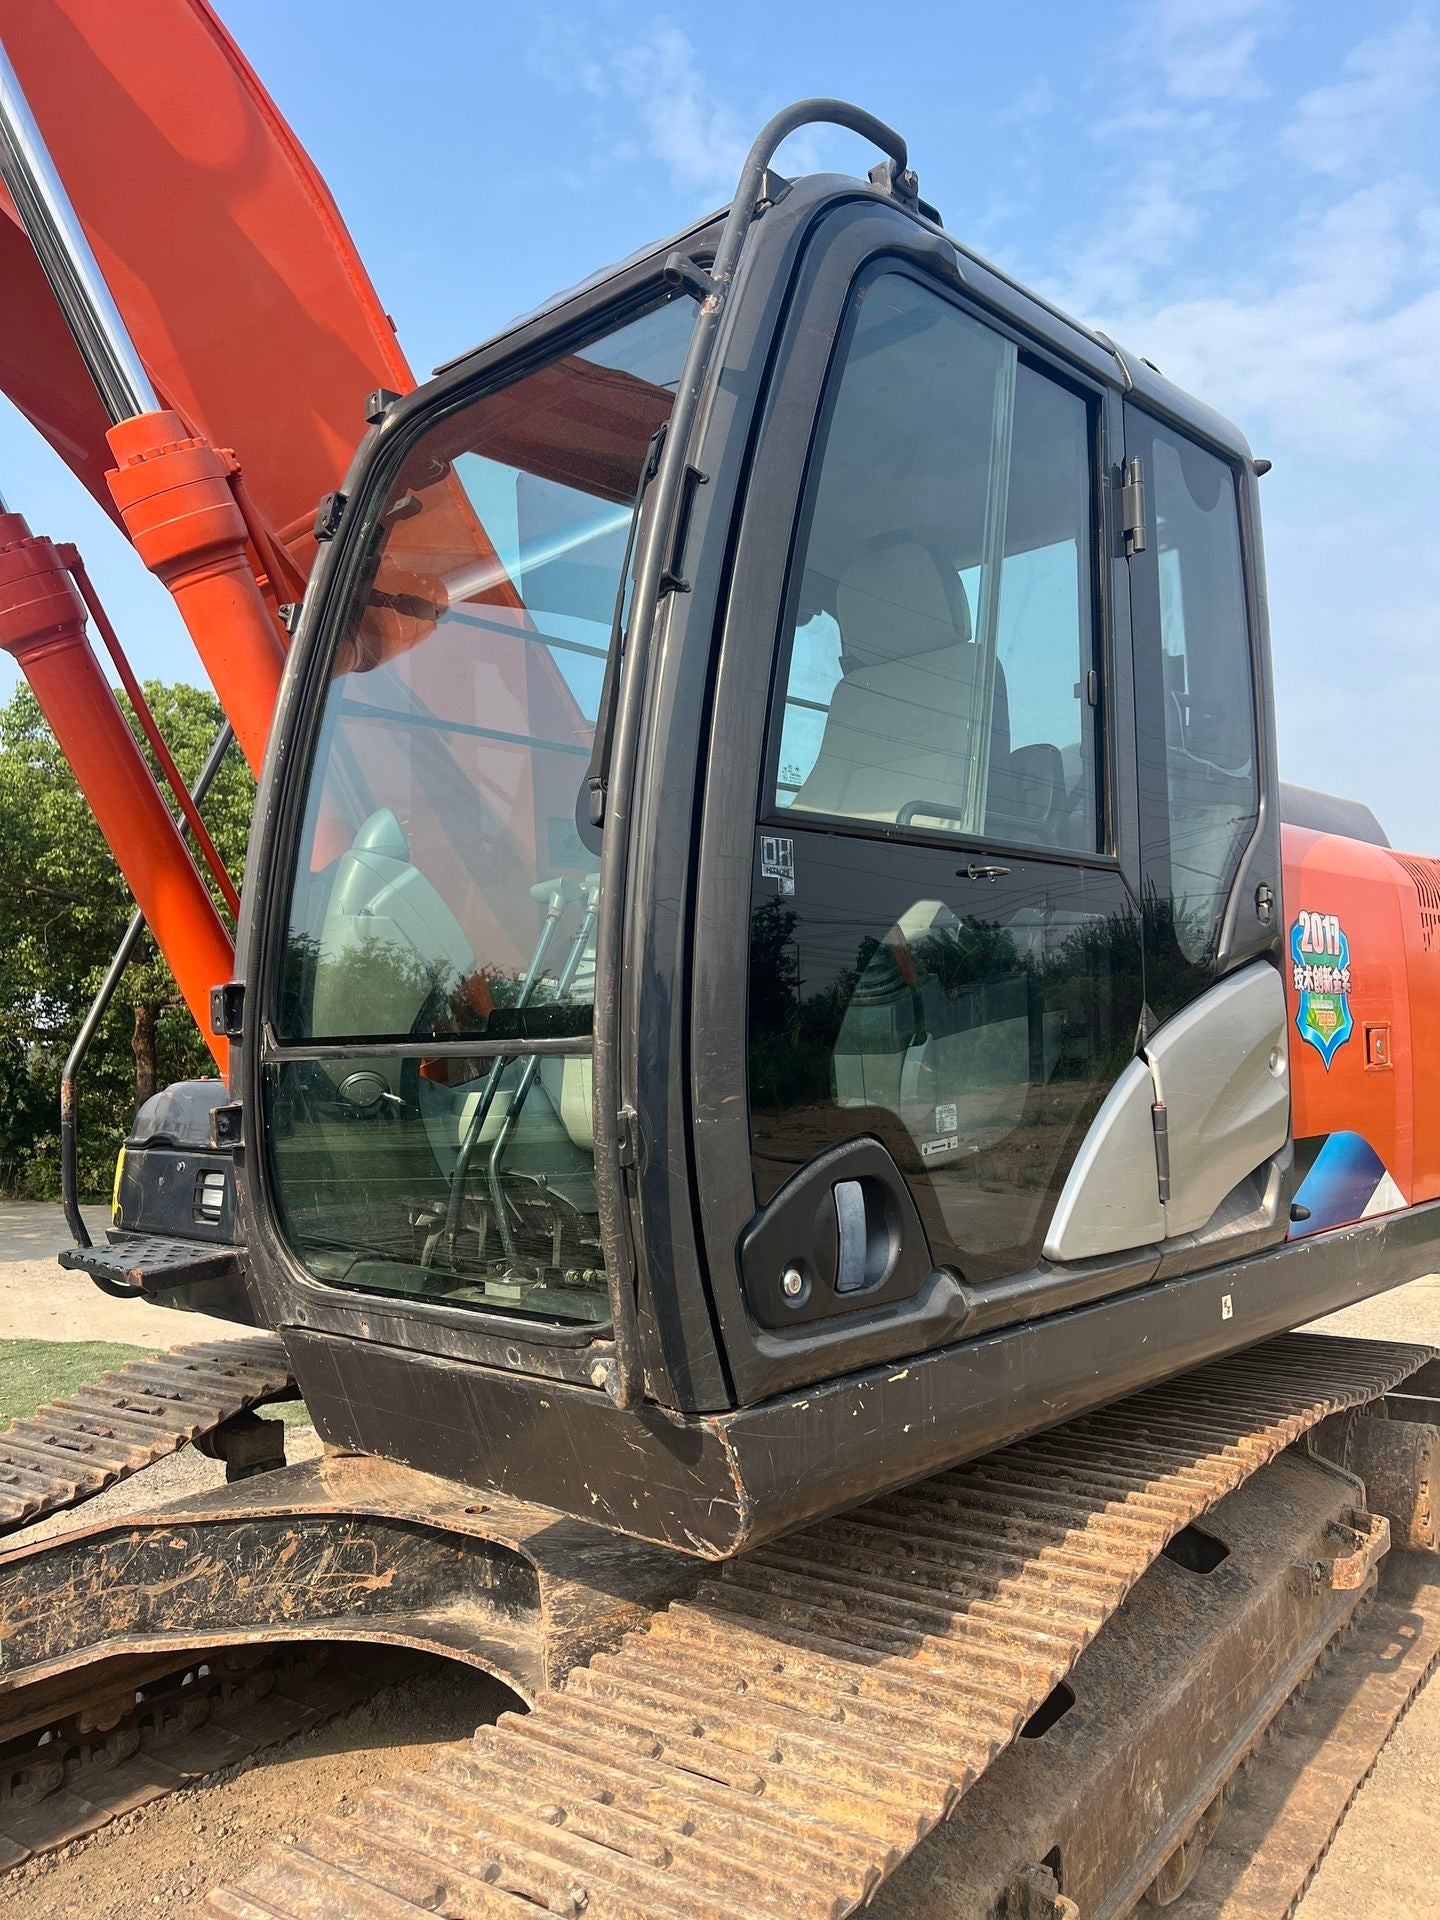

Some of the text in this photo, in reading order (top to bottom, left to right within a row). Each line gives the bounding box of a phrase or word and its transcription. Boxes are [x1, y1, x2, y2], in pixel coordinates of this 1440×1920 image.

[1299, 910, 1339, 955] 2017
[1294, 965, 1351, 994] 技术创新金奖
